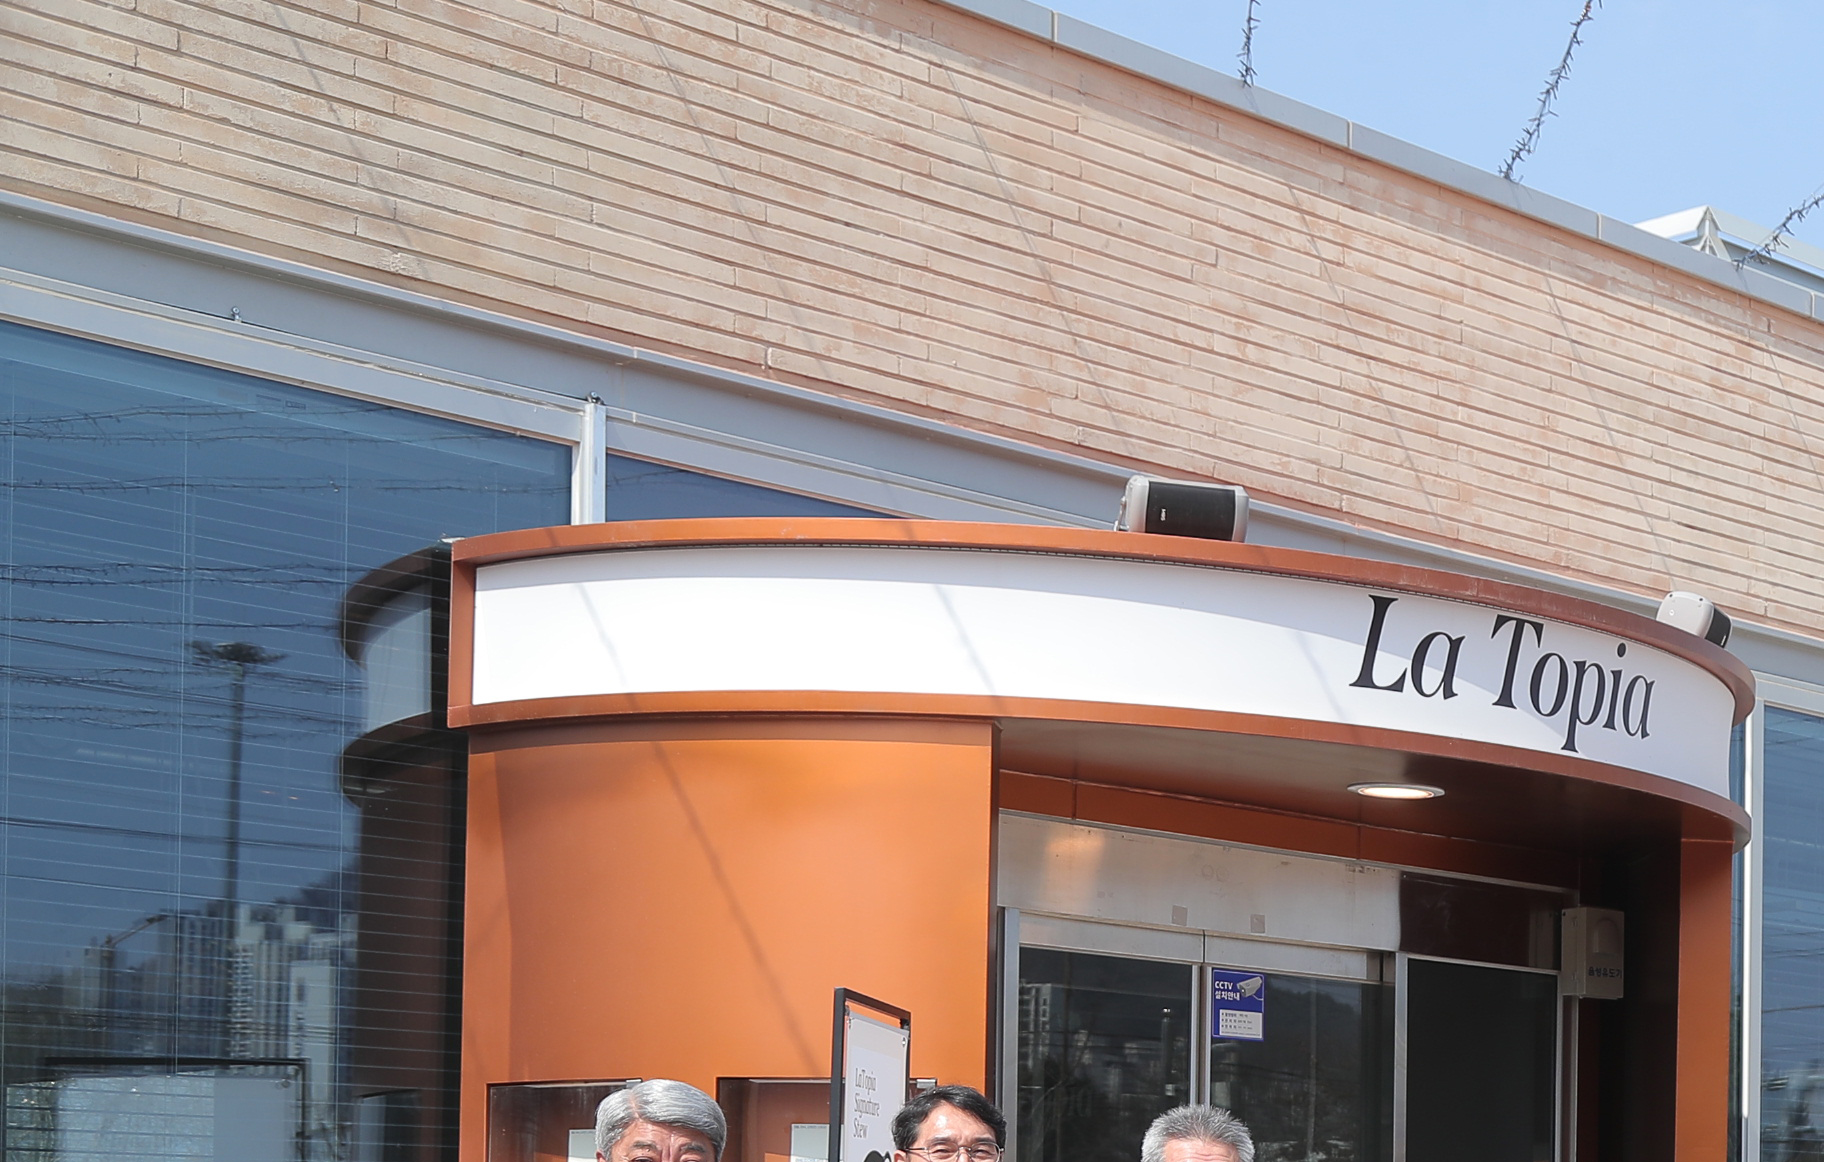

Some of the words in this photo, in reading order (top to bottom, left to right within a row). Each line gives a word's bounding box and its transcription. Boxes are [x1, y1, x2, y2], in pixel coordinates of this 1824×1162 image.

[1349, 594, 1466, 701] La
[1491, 613, 1656, 754] Topia
[1588, 966, 1623, 979] 음성유도기
[1214, 980, 1234, 990] CCTV
[1214, 990, 1241, 1001] 설치안내
[853, 1117, 868, 1139] Stew
